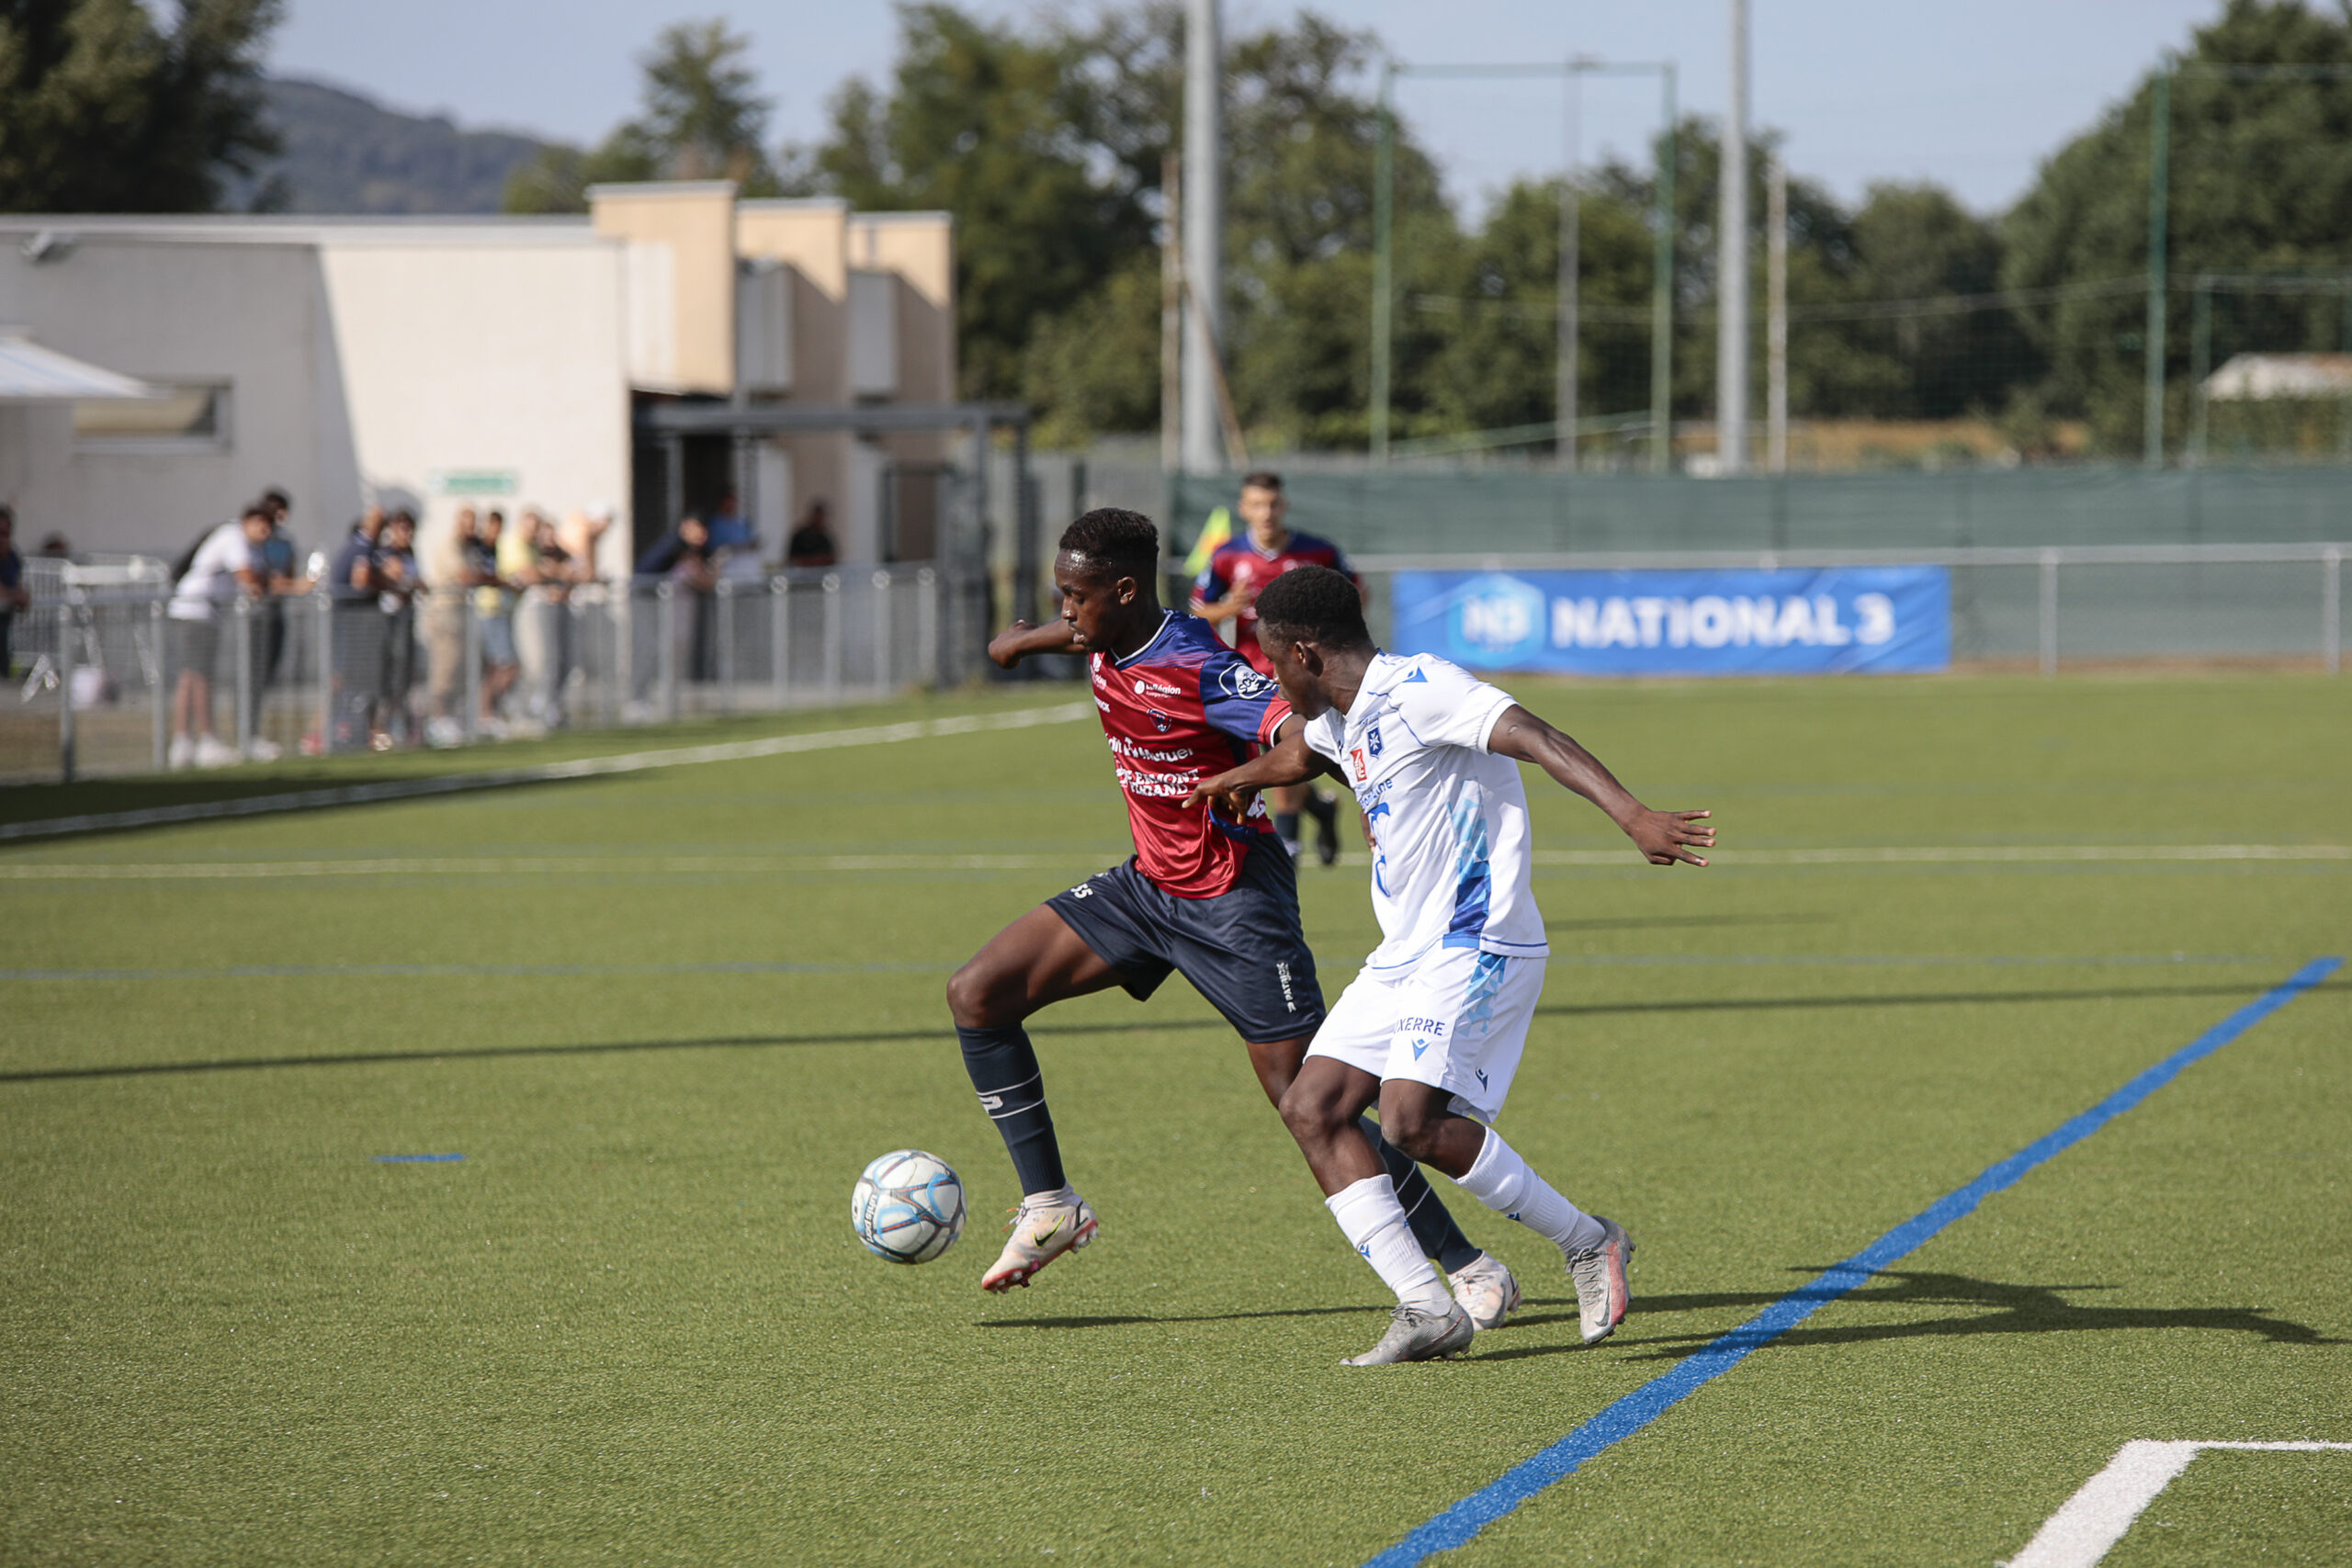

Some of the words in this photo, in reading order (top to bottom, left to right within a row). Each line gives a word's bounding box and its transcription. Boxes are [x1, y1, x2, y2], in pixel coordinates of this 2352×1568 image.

[1552, 595, 1850, 647] NATIONAL
[1852, 593, 1896, 645] 3
[1396, 1017, 1446, 1036] XERRE
